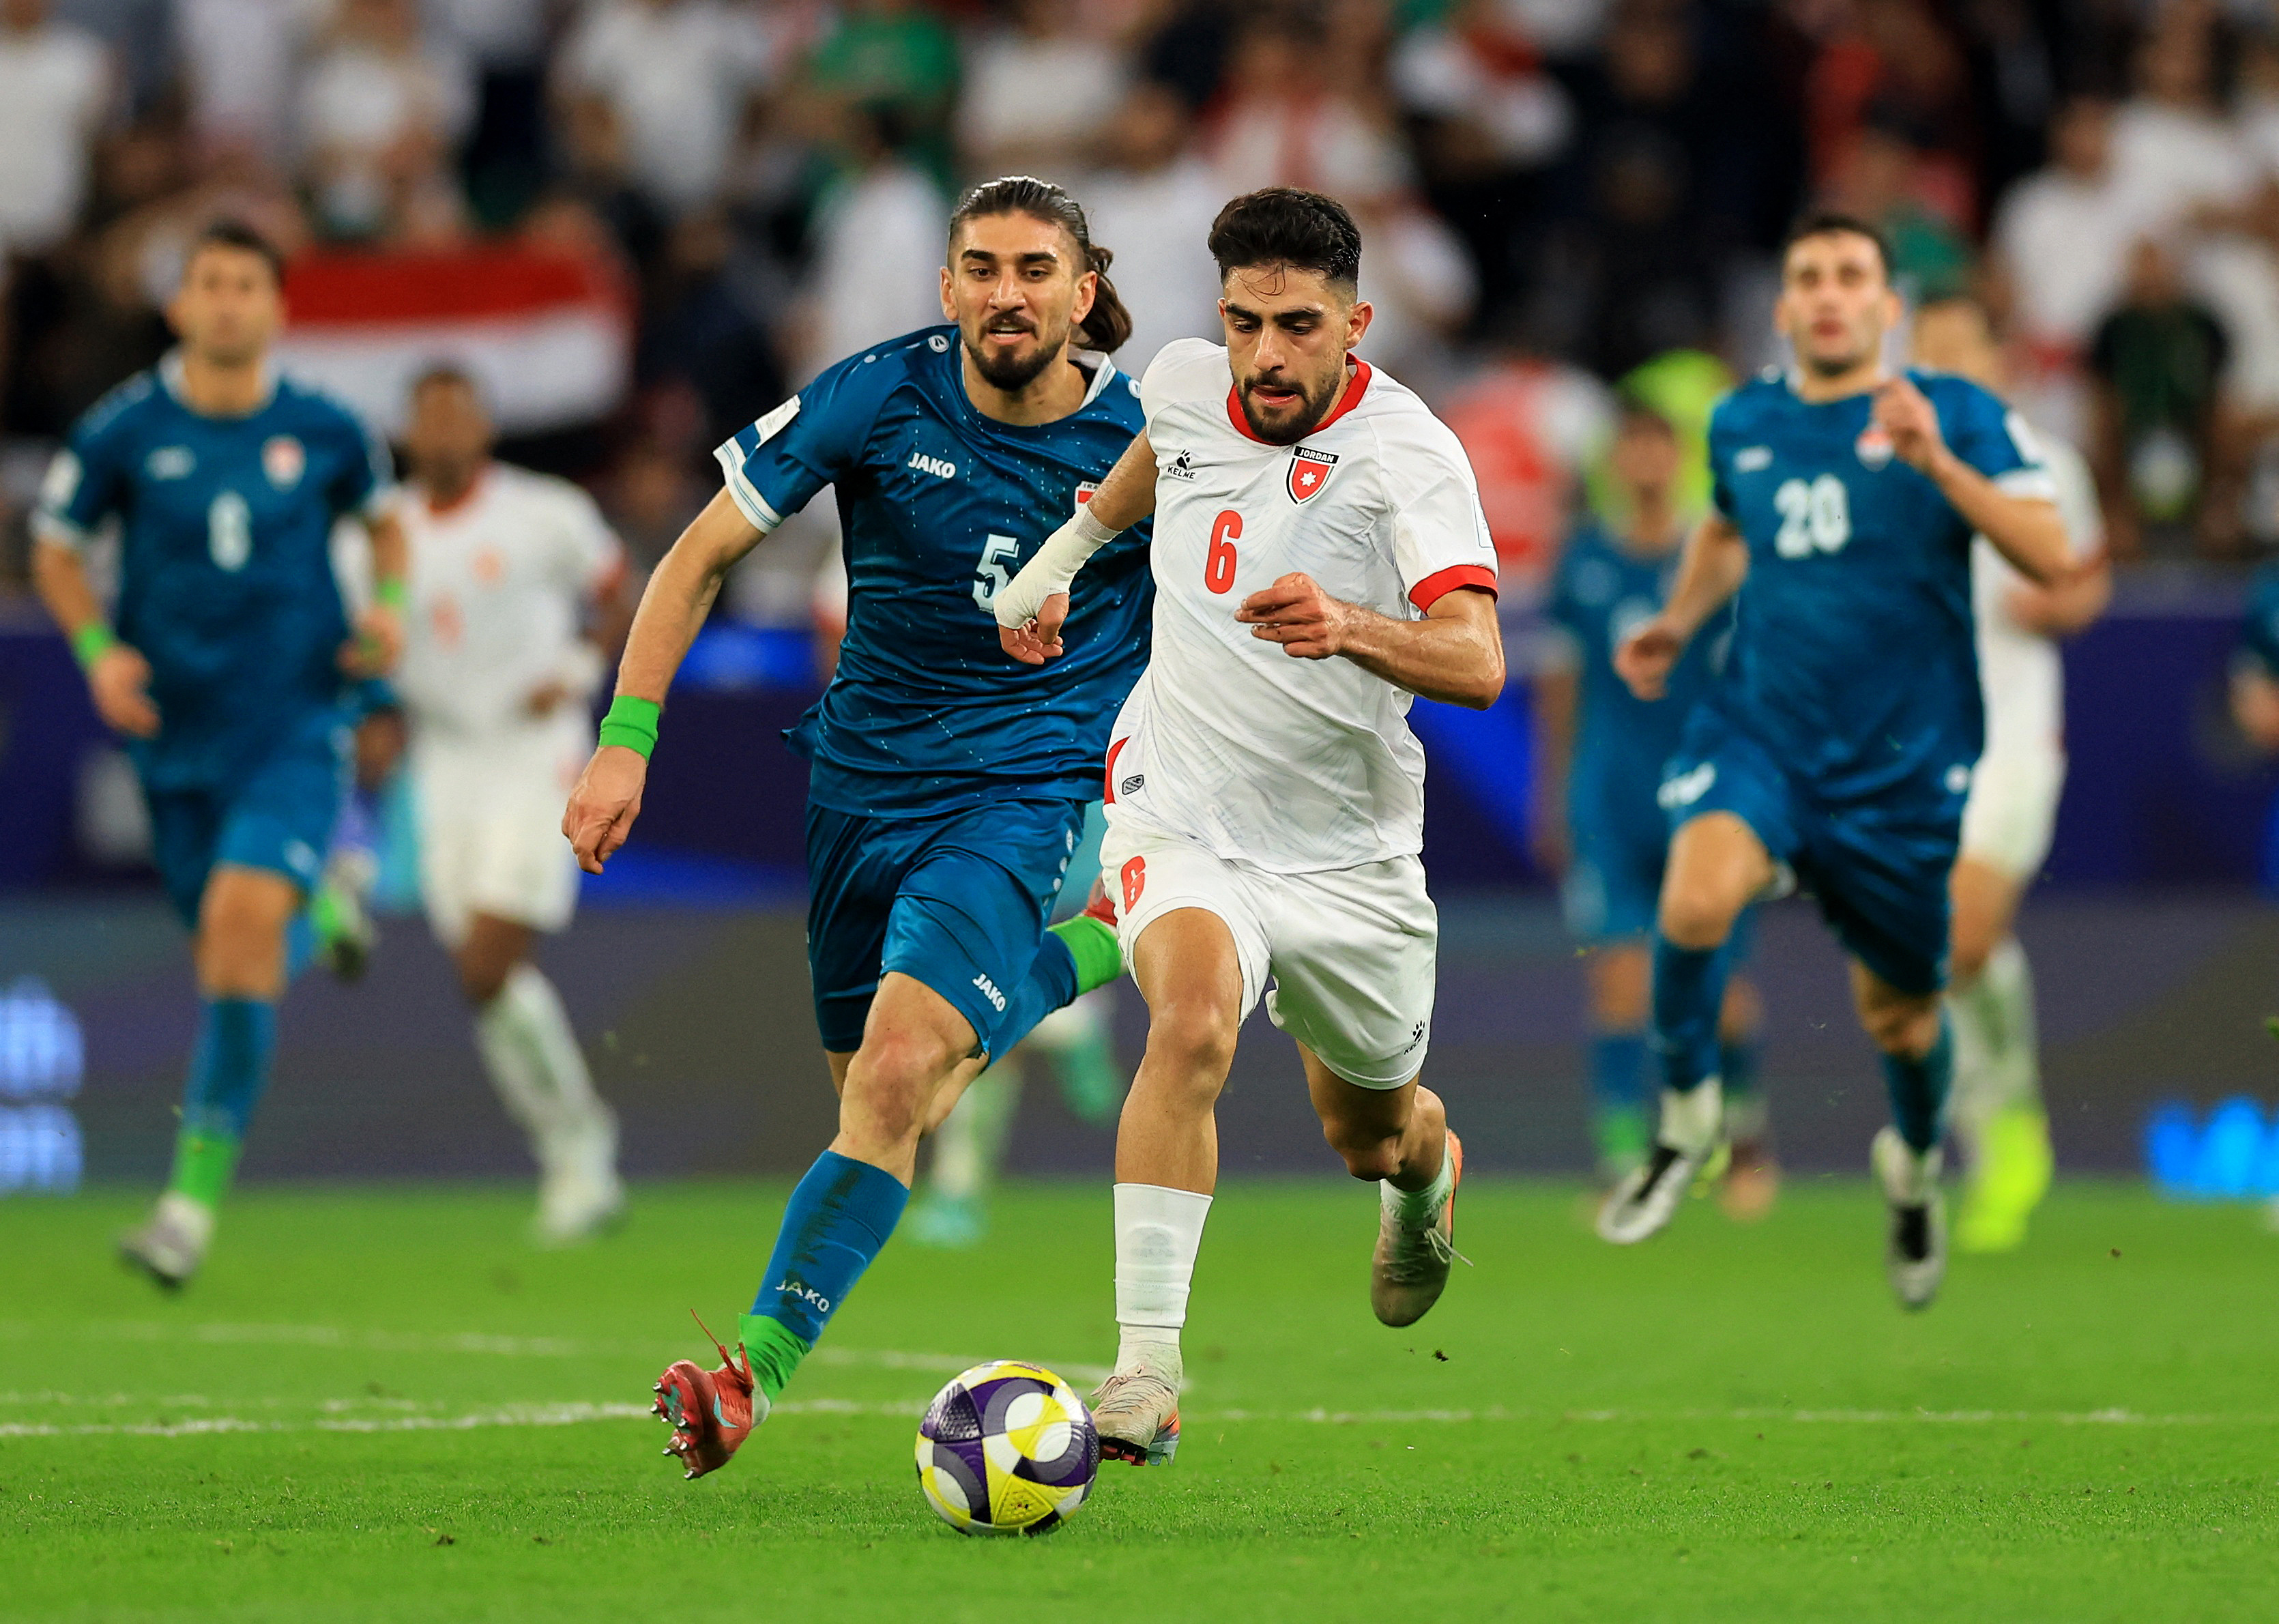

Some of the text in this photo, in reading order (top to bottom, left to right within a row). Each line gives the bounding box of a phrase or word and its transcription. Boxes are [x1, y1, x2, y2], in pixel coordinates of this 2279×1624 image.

[908, 452, 956, 479] JAKO
[1167, 465, 1195, 479] KELME
[1299, 448, 1335, 463] JORDAN
[1773, 473, 1852, 560] 20
[1204, 509, 1243, 594] 6
[972, 533, 1020, 614] 5
[1120, 855, 1146, 915] 6
[972, 973, 1006, 1012] JAKO
[775, 1279, 830, 1313] JAKO
